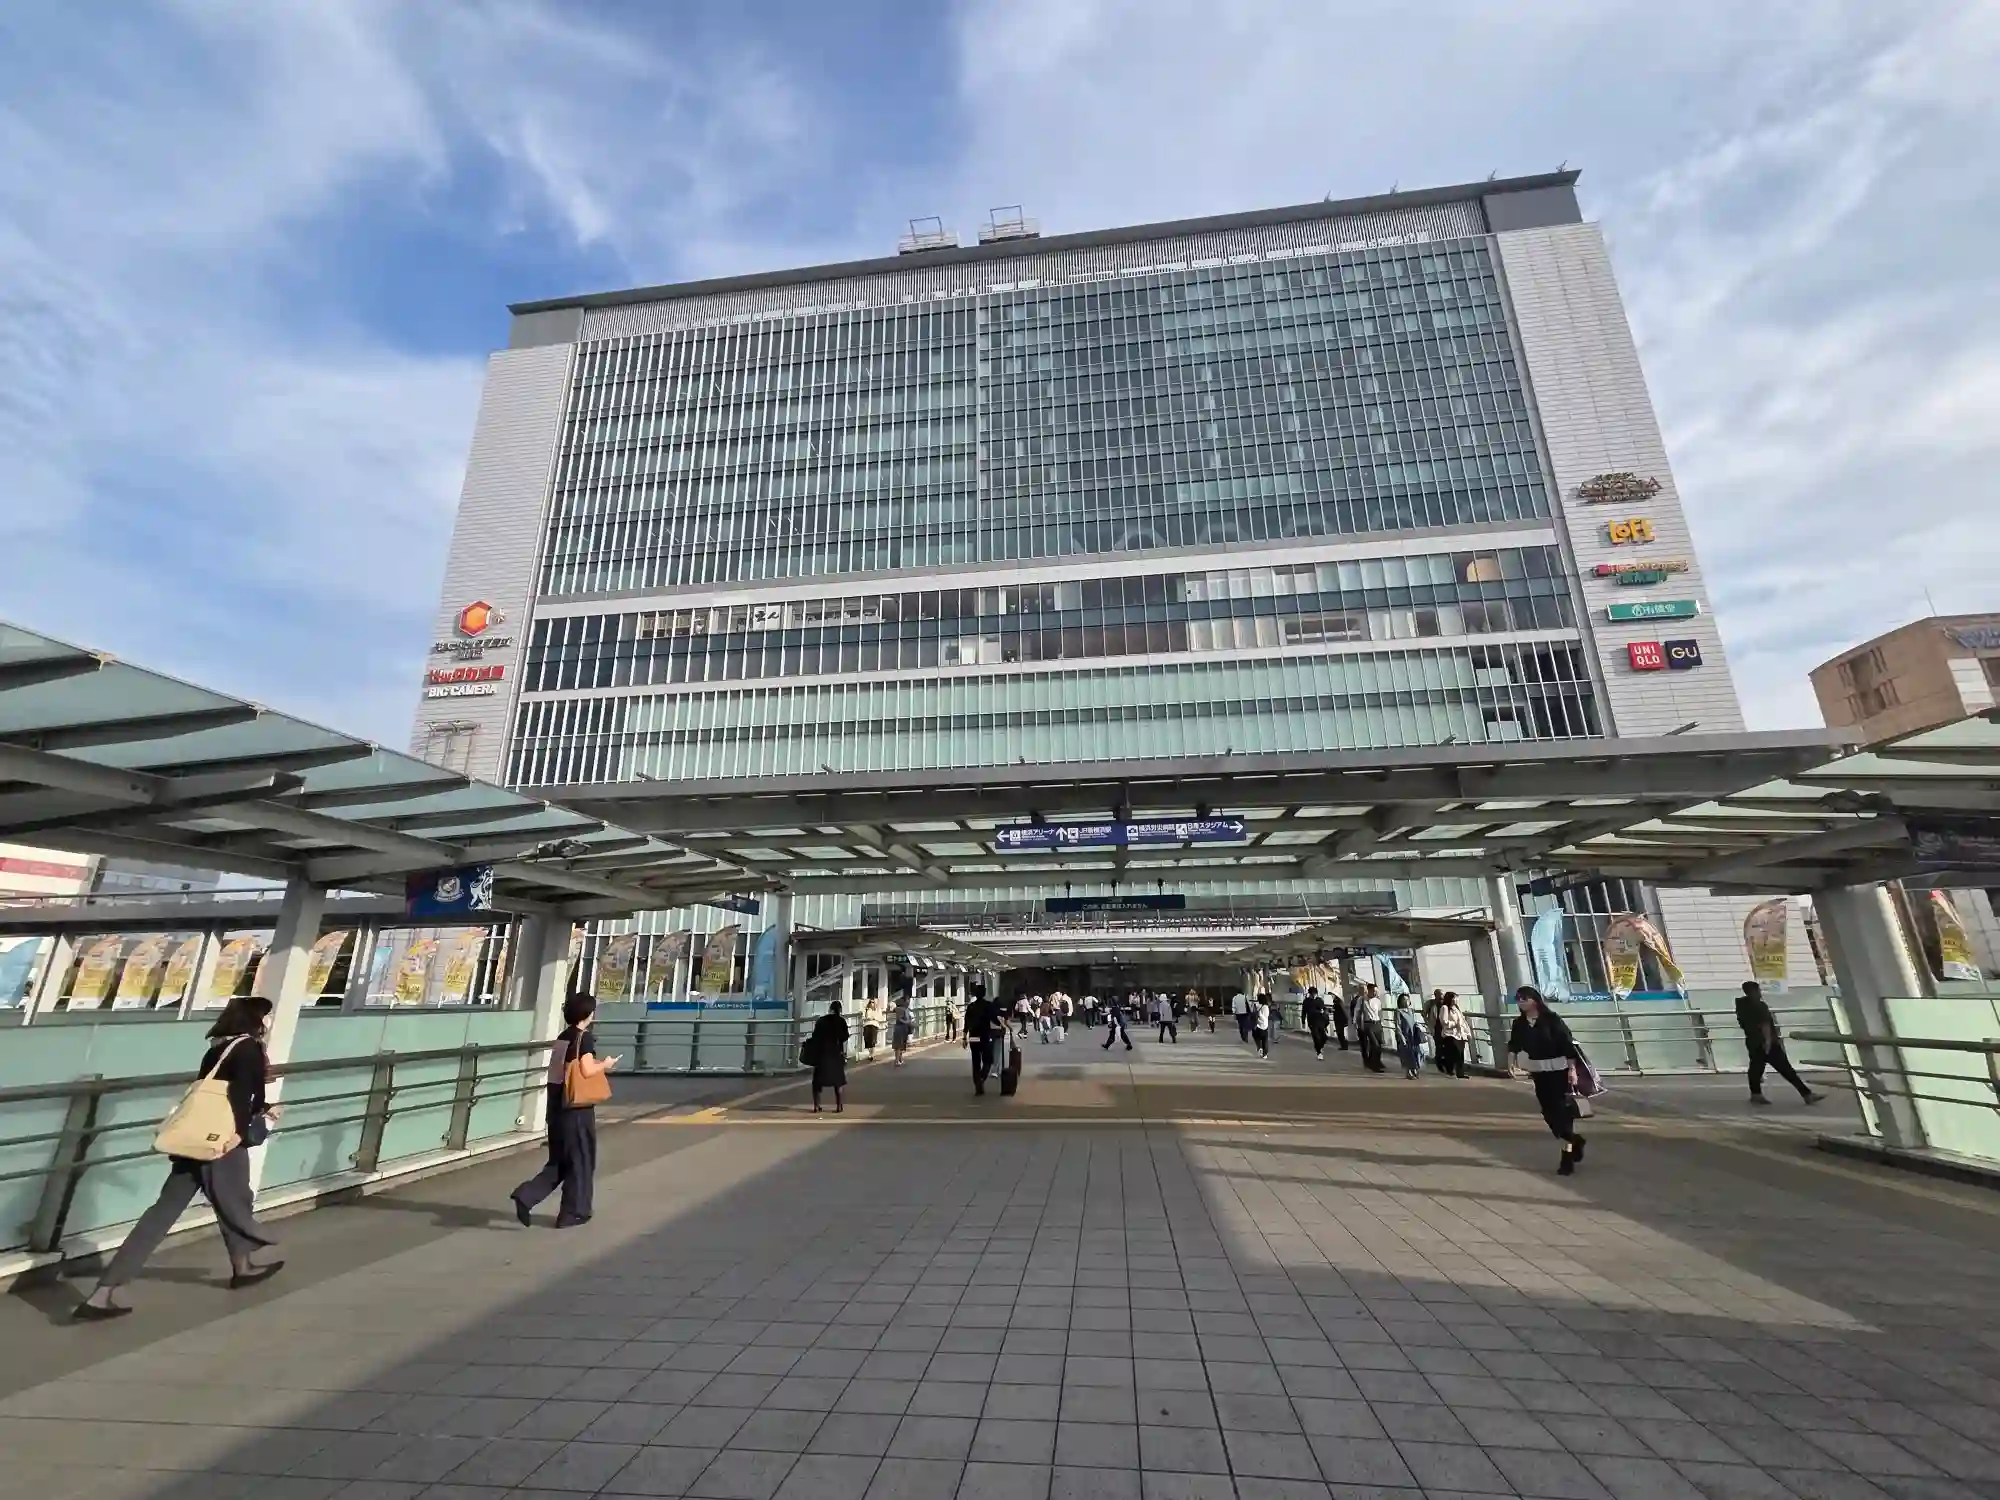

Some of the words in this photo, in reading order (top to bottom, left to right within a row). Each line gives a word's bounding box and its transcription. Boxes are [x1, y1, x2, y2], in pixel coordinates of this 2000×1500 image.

[1634, 645, 1656, 655] UNI
[1671, 646, 1699, 659] GU
[1636, 655, 1661, 666] QLO
[427, 686, 450, 698] BIC
[450, 684, 498, 696] CAMERA
